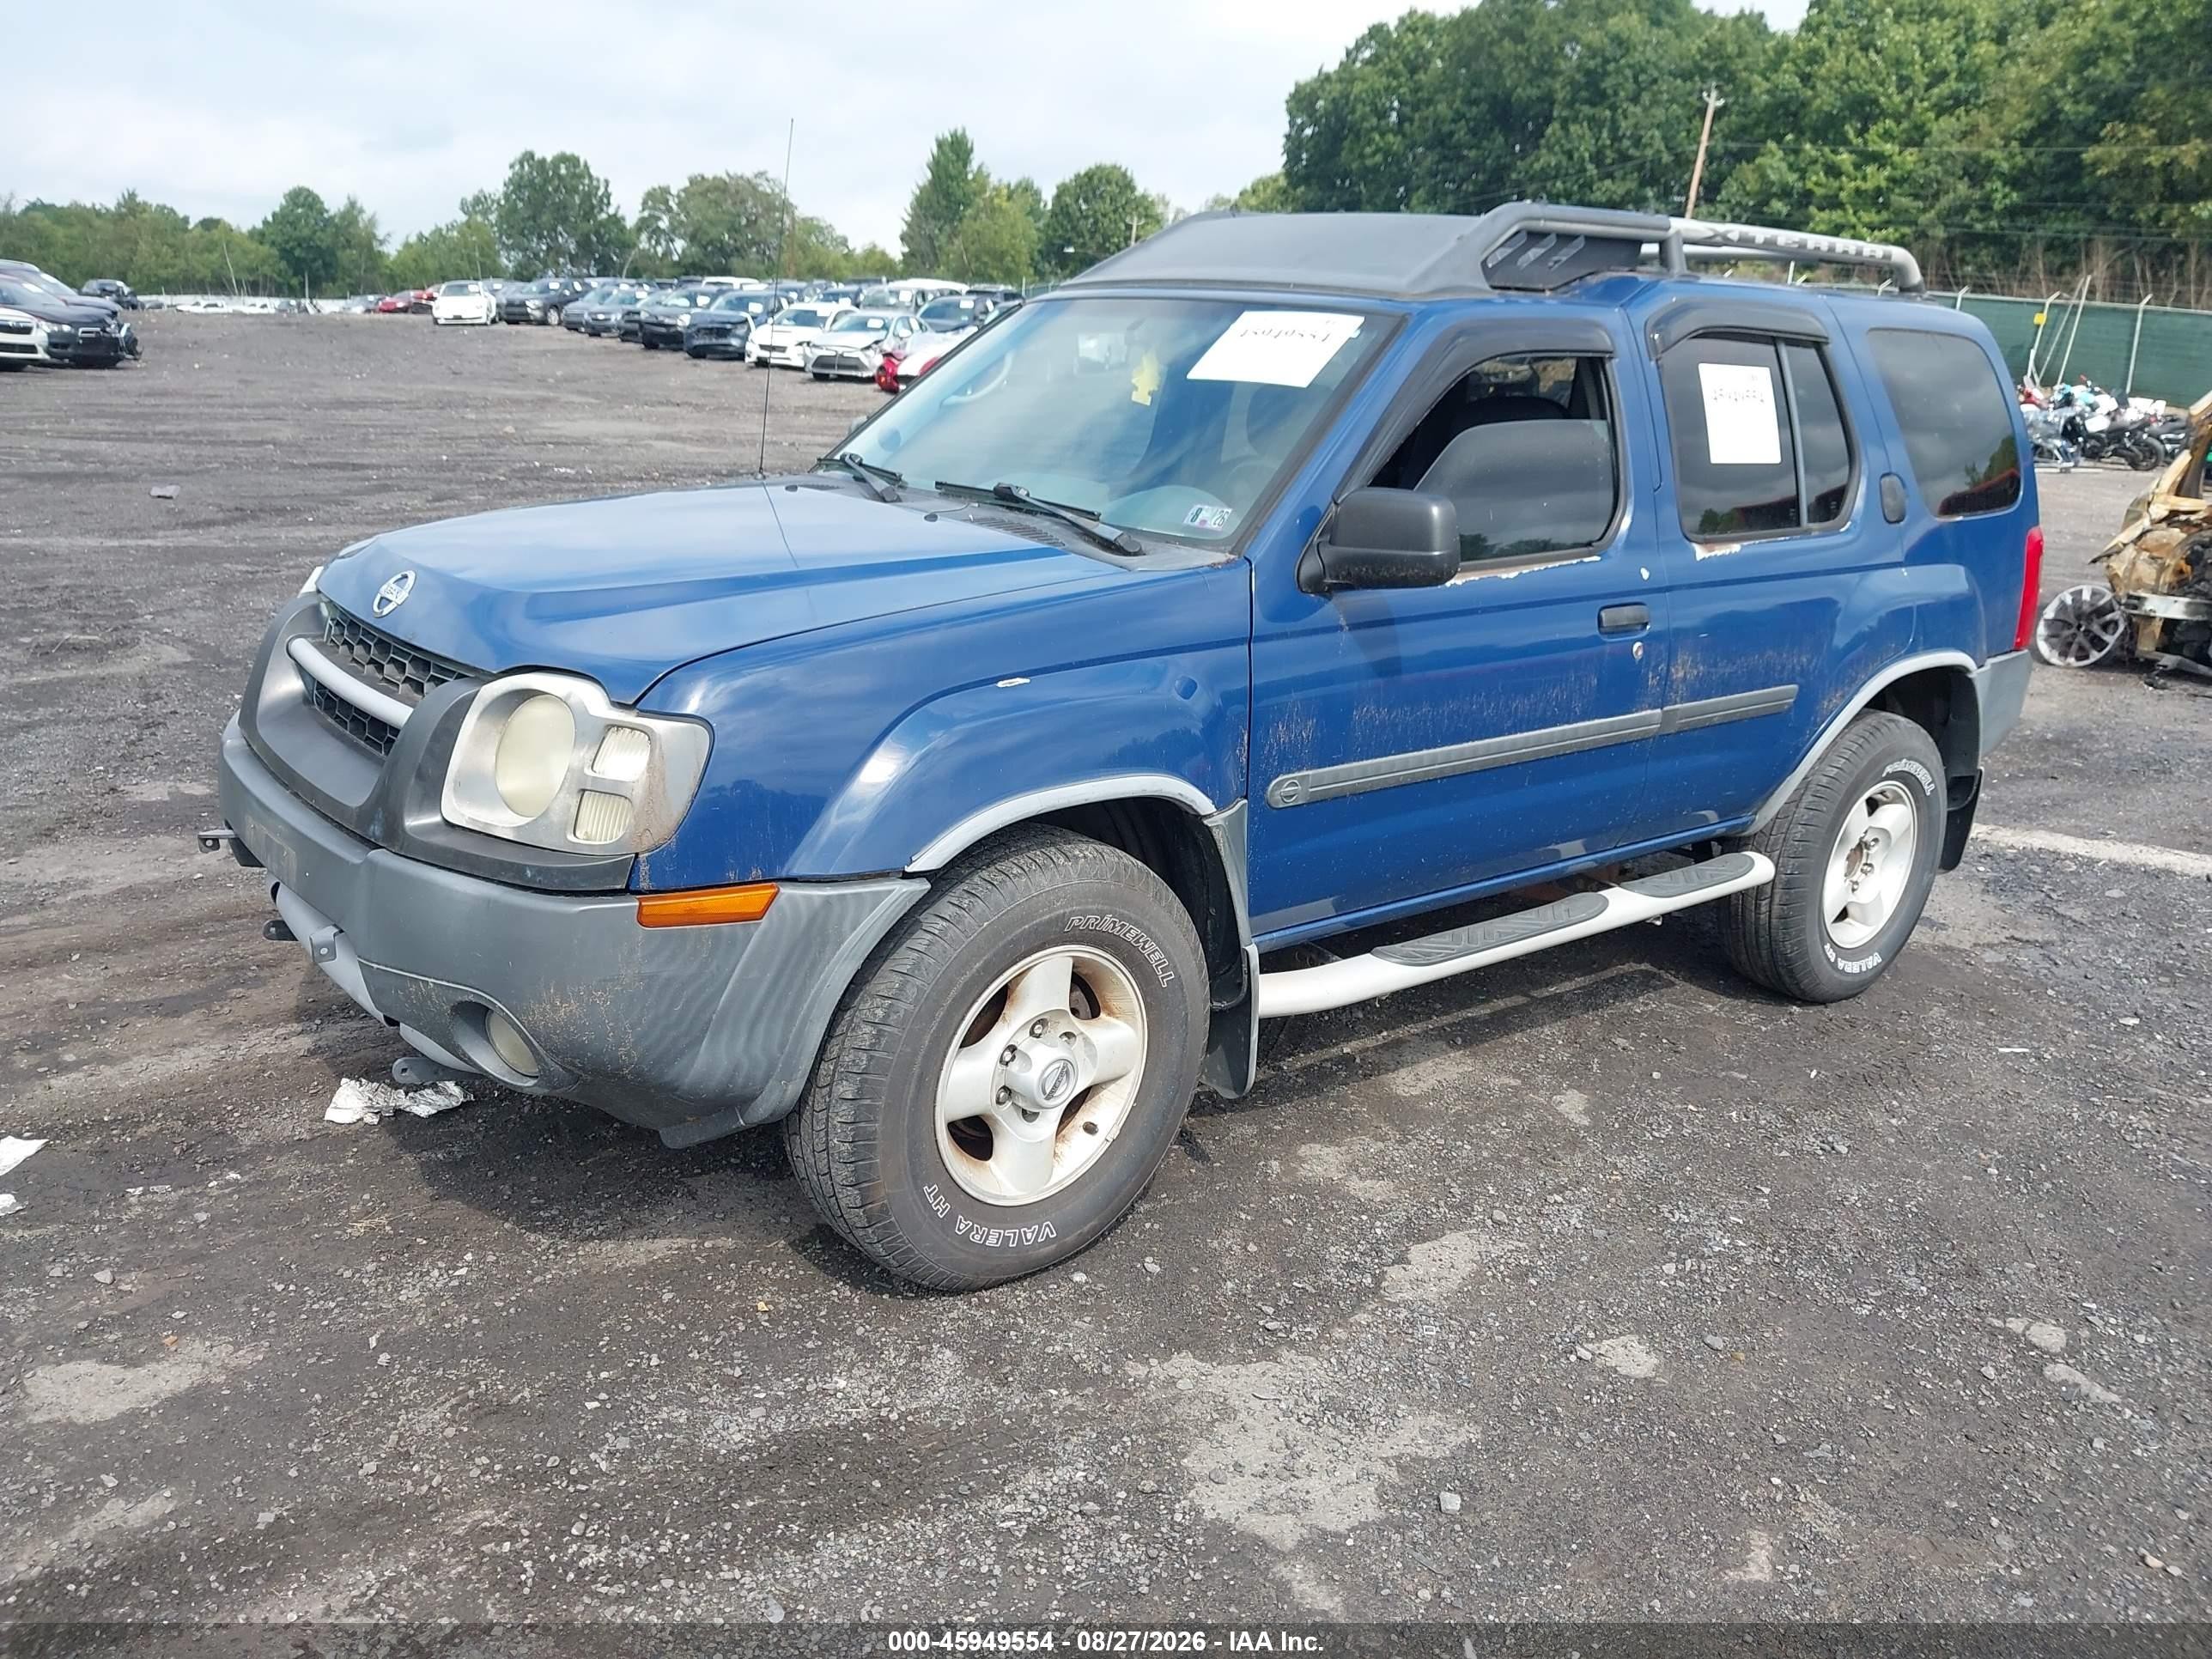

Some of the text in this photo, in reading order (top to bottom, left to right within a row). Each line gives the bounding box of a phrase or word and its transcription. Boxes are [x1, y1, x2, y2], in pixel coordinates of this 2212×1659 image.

[1190, 507, 1203, 523] 8
[923, 1184, 1057, 1247] VALERA HT
